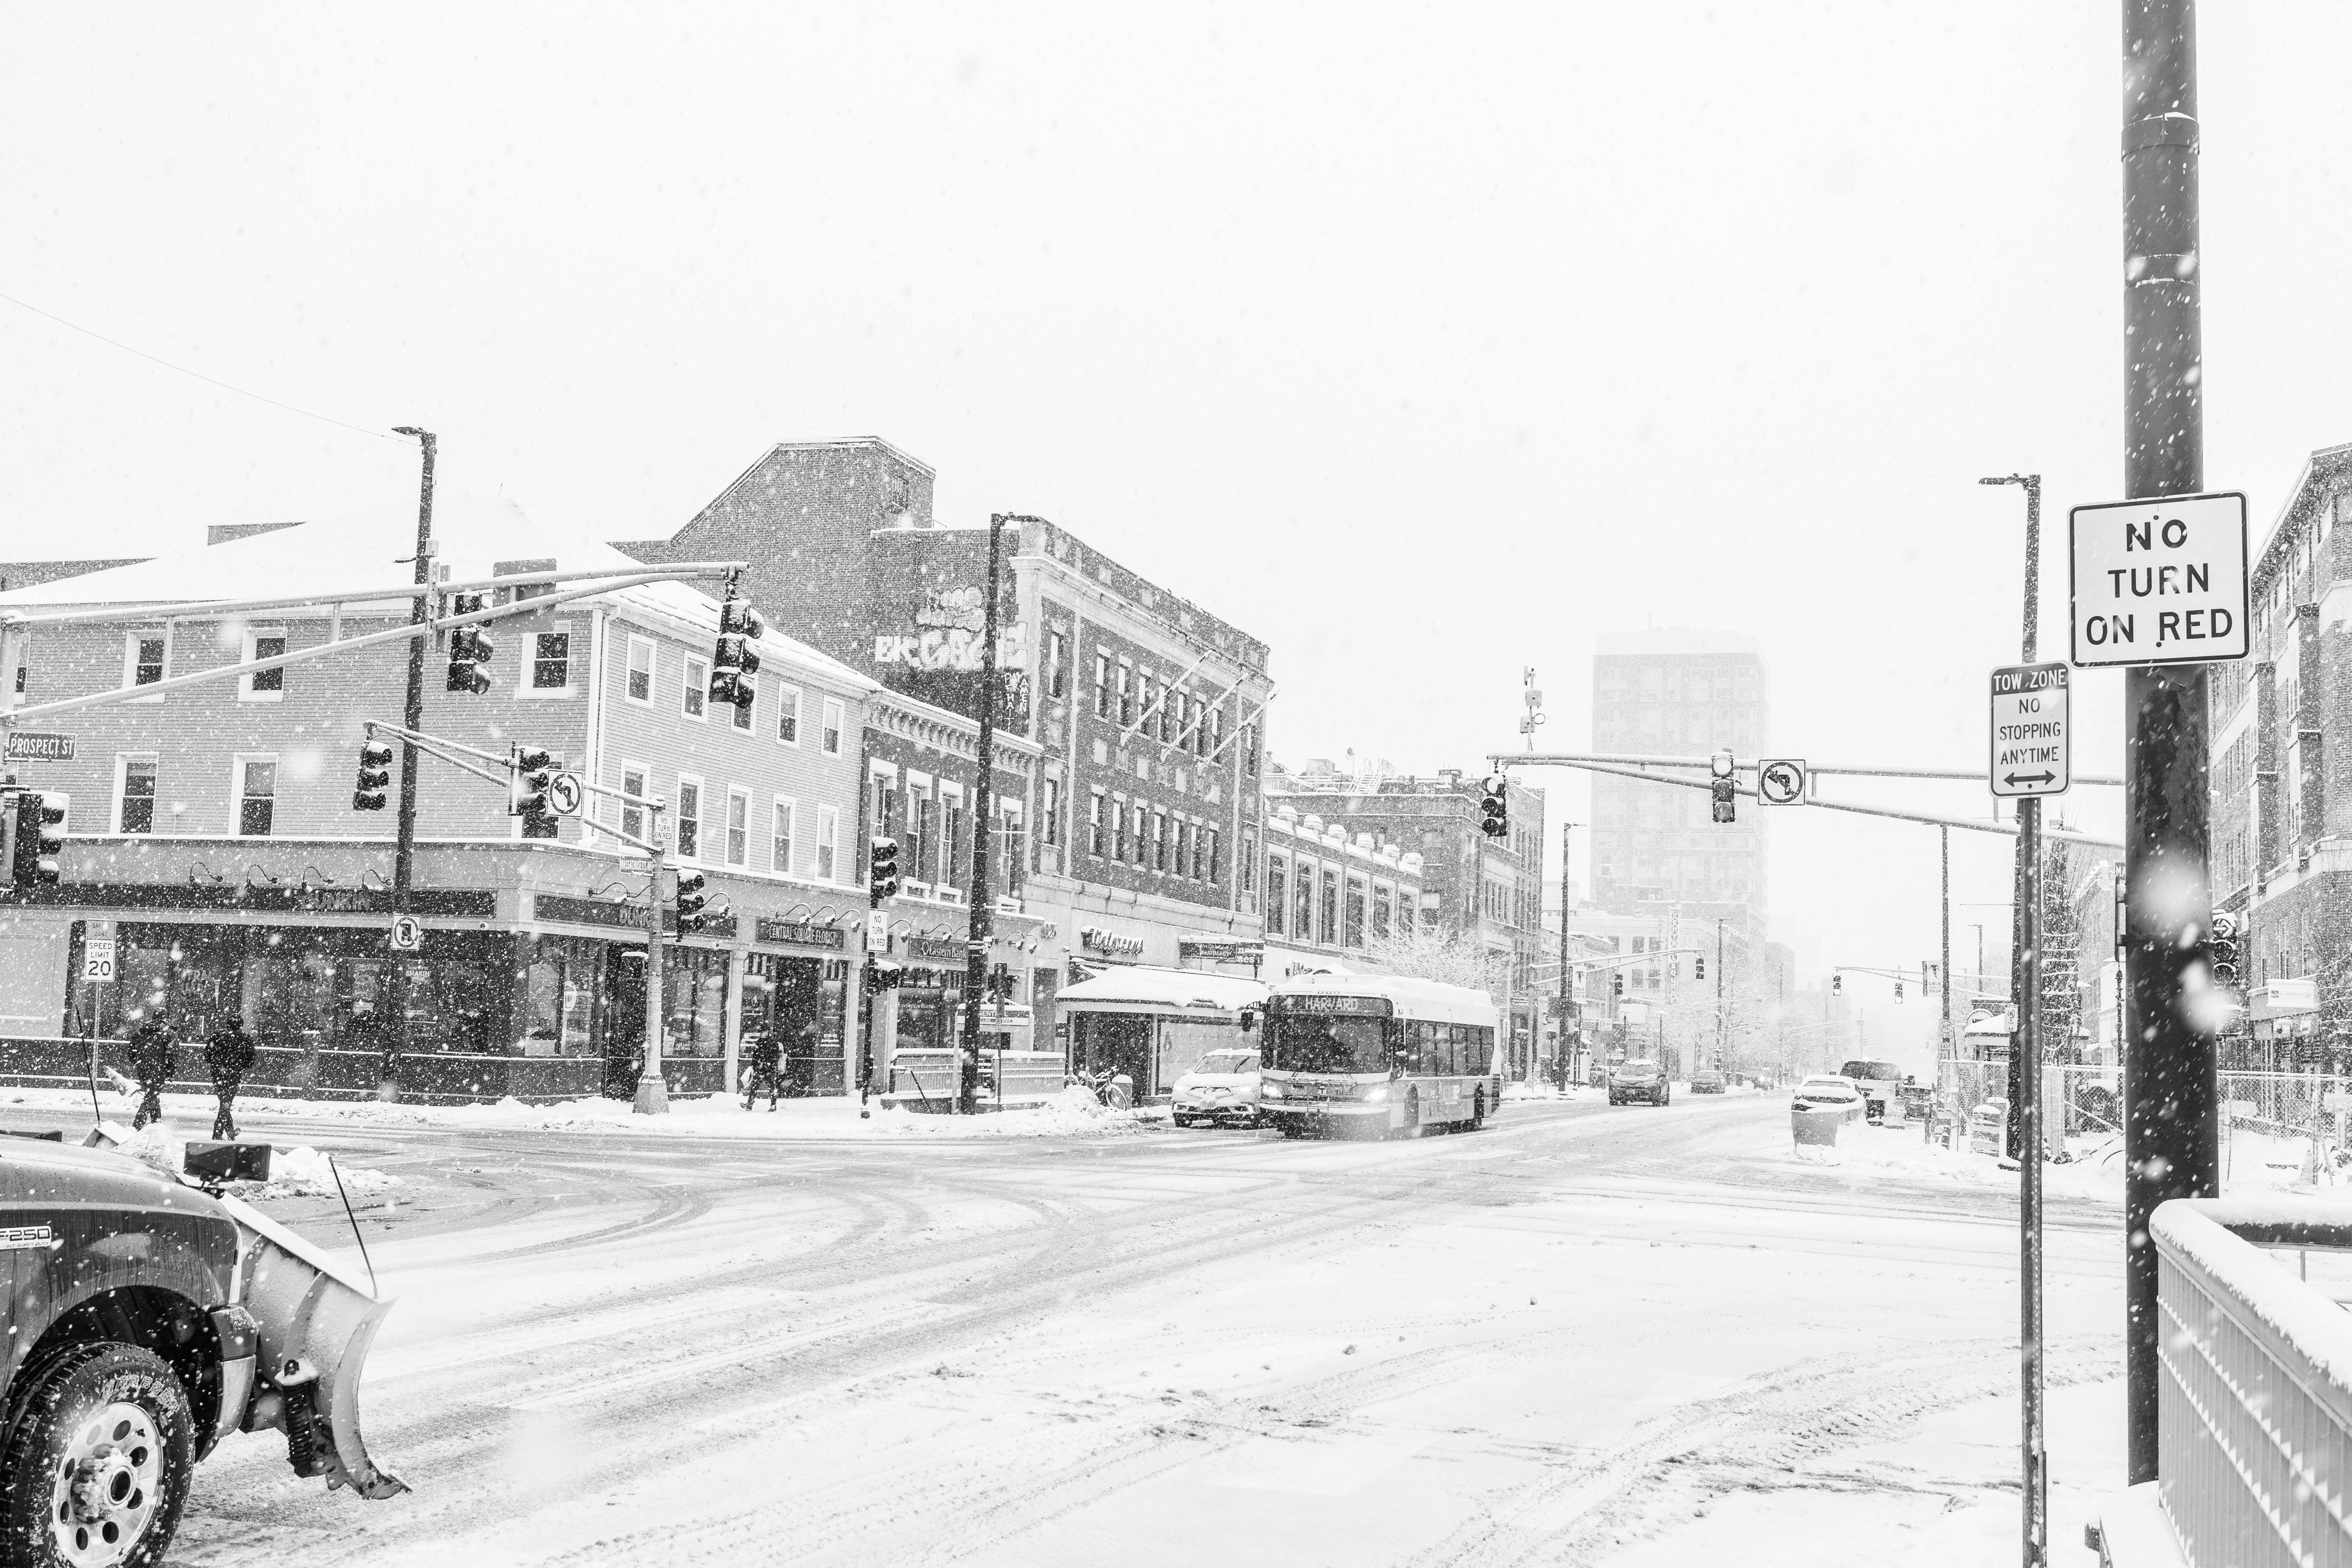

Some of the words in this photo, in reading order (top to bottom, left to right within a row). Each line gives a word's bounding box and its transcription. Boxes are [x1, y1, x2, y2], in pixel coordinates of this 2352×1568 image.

[2126, 519, 2188, 552] NO
[2108, 562, 2209, 598] TURN
[2086, 613, 2134, 645] ON
[2159, 608, 2233, 641] RED
[1994, 673, 2022, 691] TOW
[2030, 669, 2066, 688] ZONE
[1019, 678, 1029, 712] AMEN
[2019, 698, 2040, 714] NO
[1999, 721, 2061, 741] STOPPING
[10, 738, 60, 756] PROSPECT
[62, 739, 74, 755] ST
[2000, 746, 2059, 765] ANYTIME
[769, 924, 792, 940] CENTRAL
[794, 927, 815, 942] SQUARE
[815, 929, 836, 946] FLORIST
[1088, 928, 1144, 956] Walgreens
[929, 944, 951, 957] Eastern
[952, 947, 966, 958] Bank
[88, 960, 111, 976] 20
[1305, 997, 1358, 1010] HARVARD
[2280, 990, 2312, 999] Cambridge
[102, 1374, 180, 1418] GRABBER
